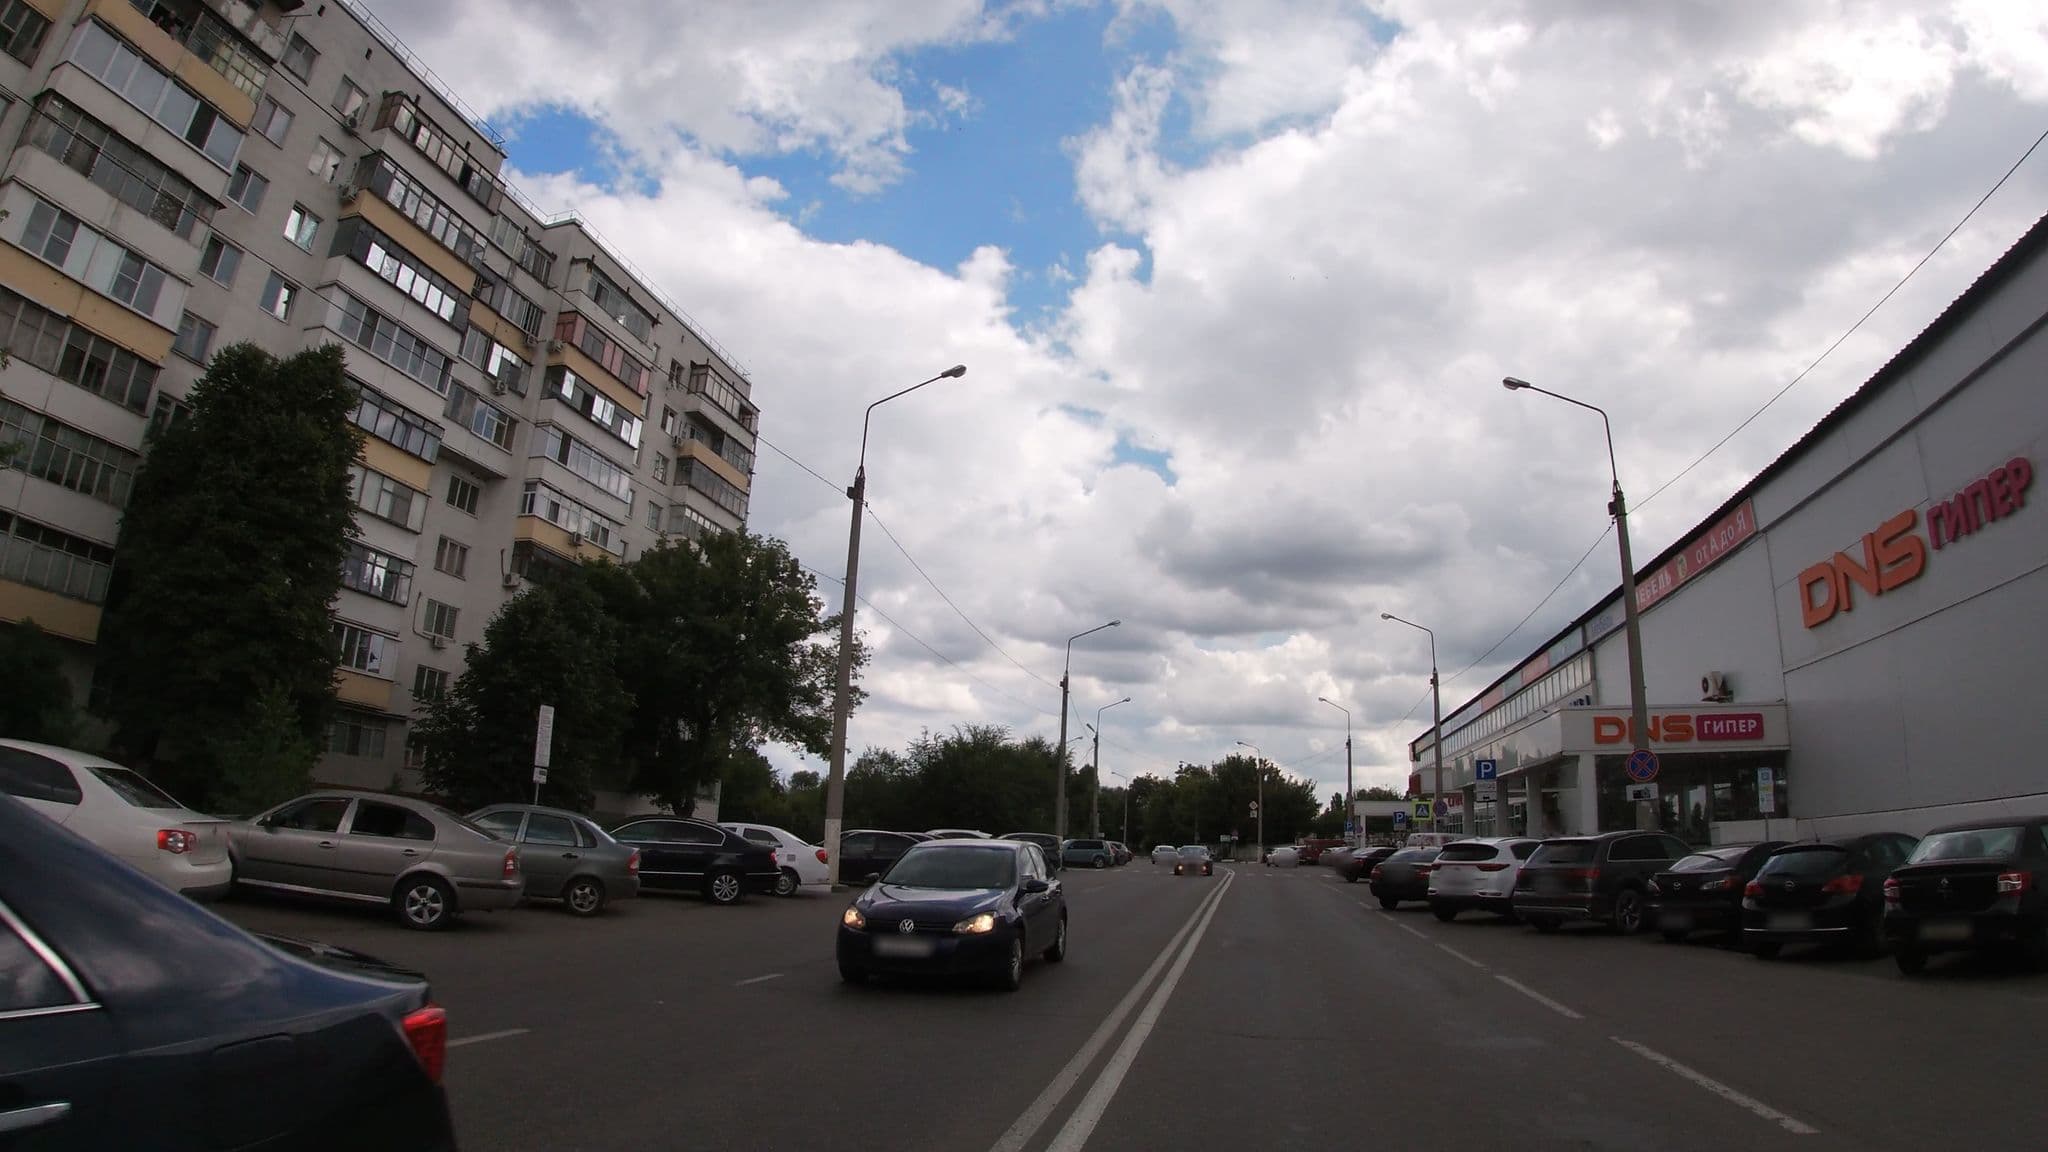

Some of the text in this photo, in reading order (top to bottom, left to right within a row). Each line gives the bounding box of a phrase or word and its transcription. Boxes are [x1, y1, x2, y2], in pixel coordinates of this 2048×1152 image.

[1926, 457, 2033, 550] ГИПЕР
[1635, 570, 1672, 606] ЕБЕЛЬ
[1798, 509, 1926, 629] DNS
[1703, 718, 1757, 735] ГИПЕР
